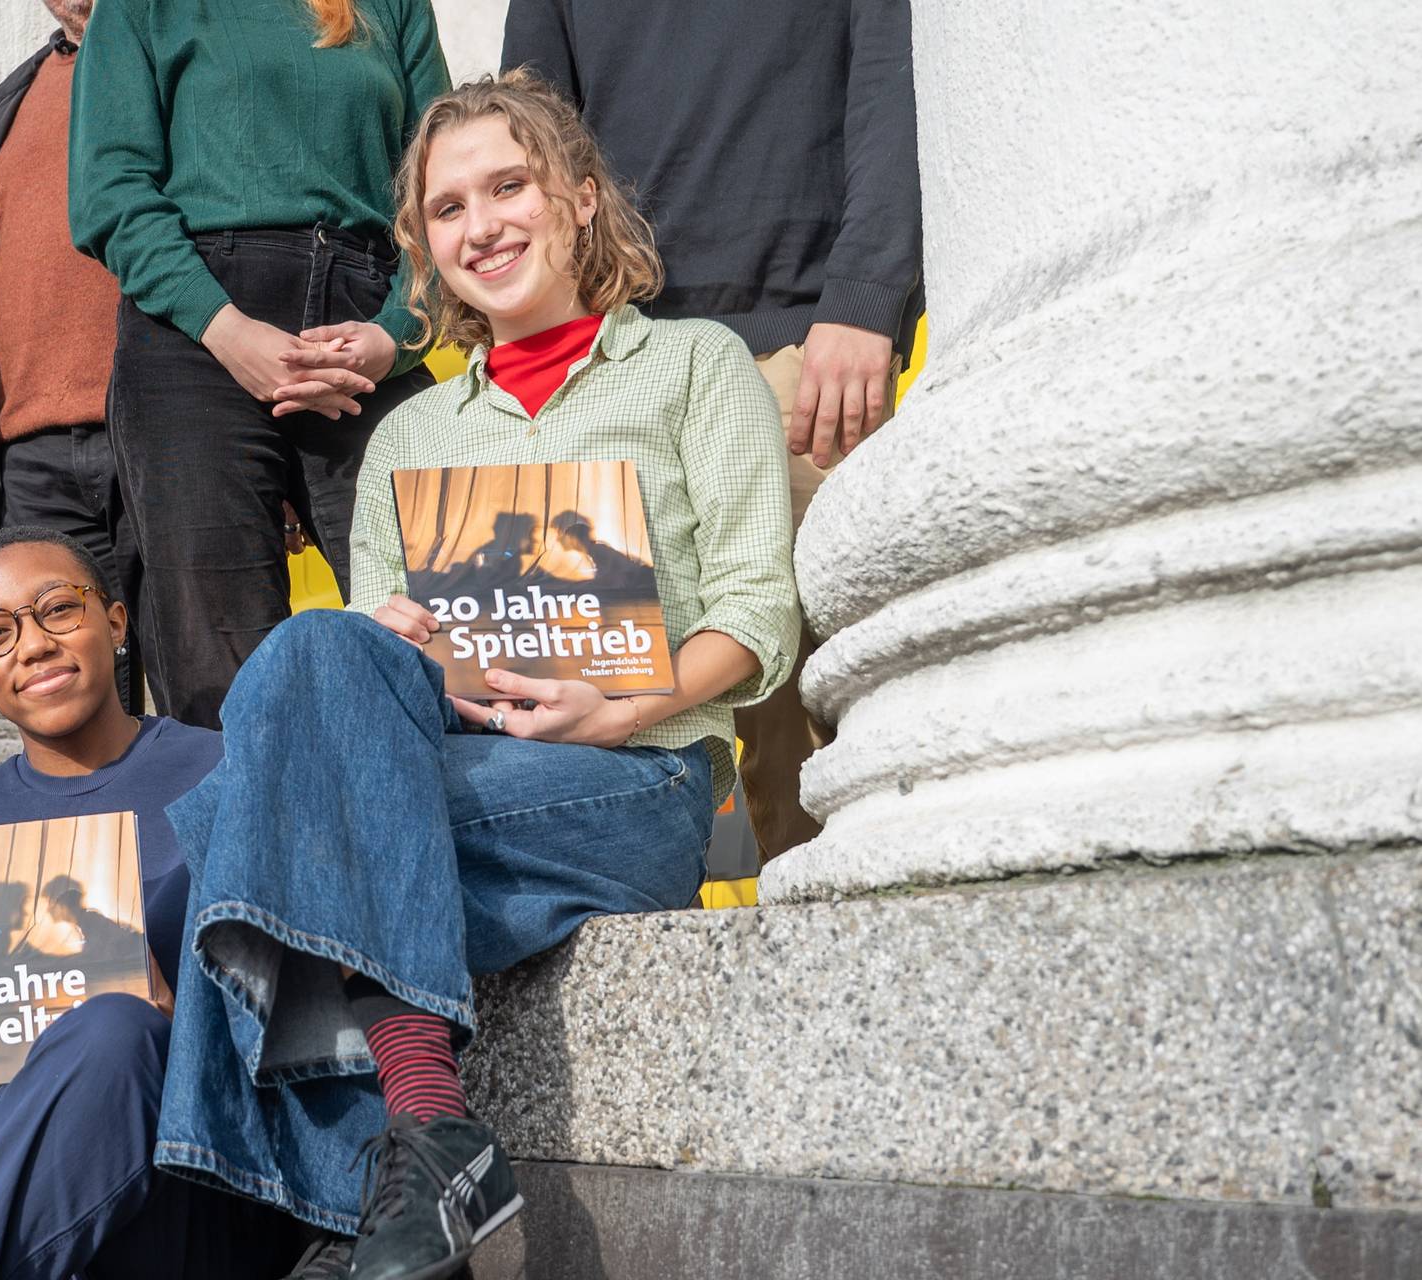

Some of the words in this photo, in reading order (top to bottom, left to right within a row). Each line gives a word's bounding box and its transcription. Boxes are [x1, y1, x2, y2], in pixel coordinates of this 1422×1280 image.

[428, 596, 480, 623] 20
[490, 585, 601, 621] Jahre
[449, 619, 652, 669] Spieltrieb
[580, 667, 614, 677] Theater
[614, 666, 655, 676] Duisburg
[591, 656, 639, 667] Jugendclub
[640, 657, 653, 665] im
